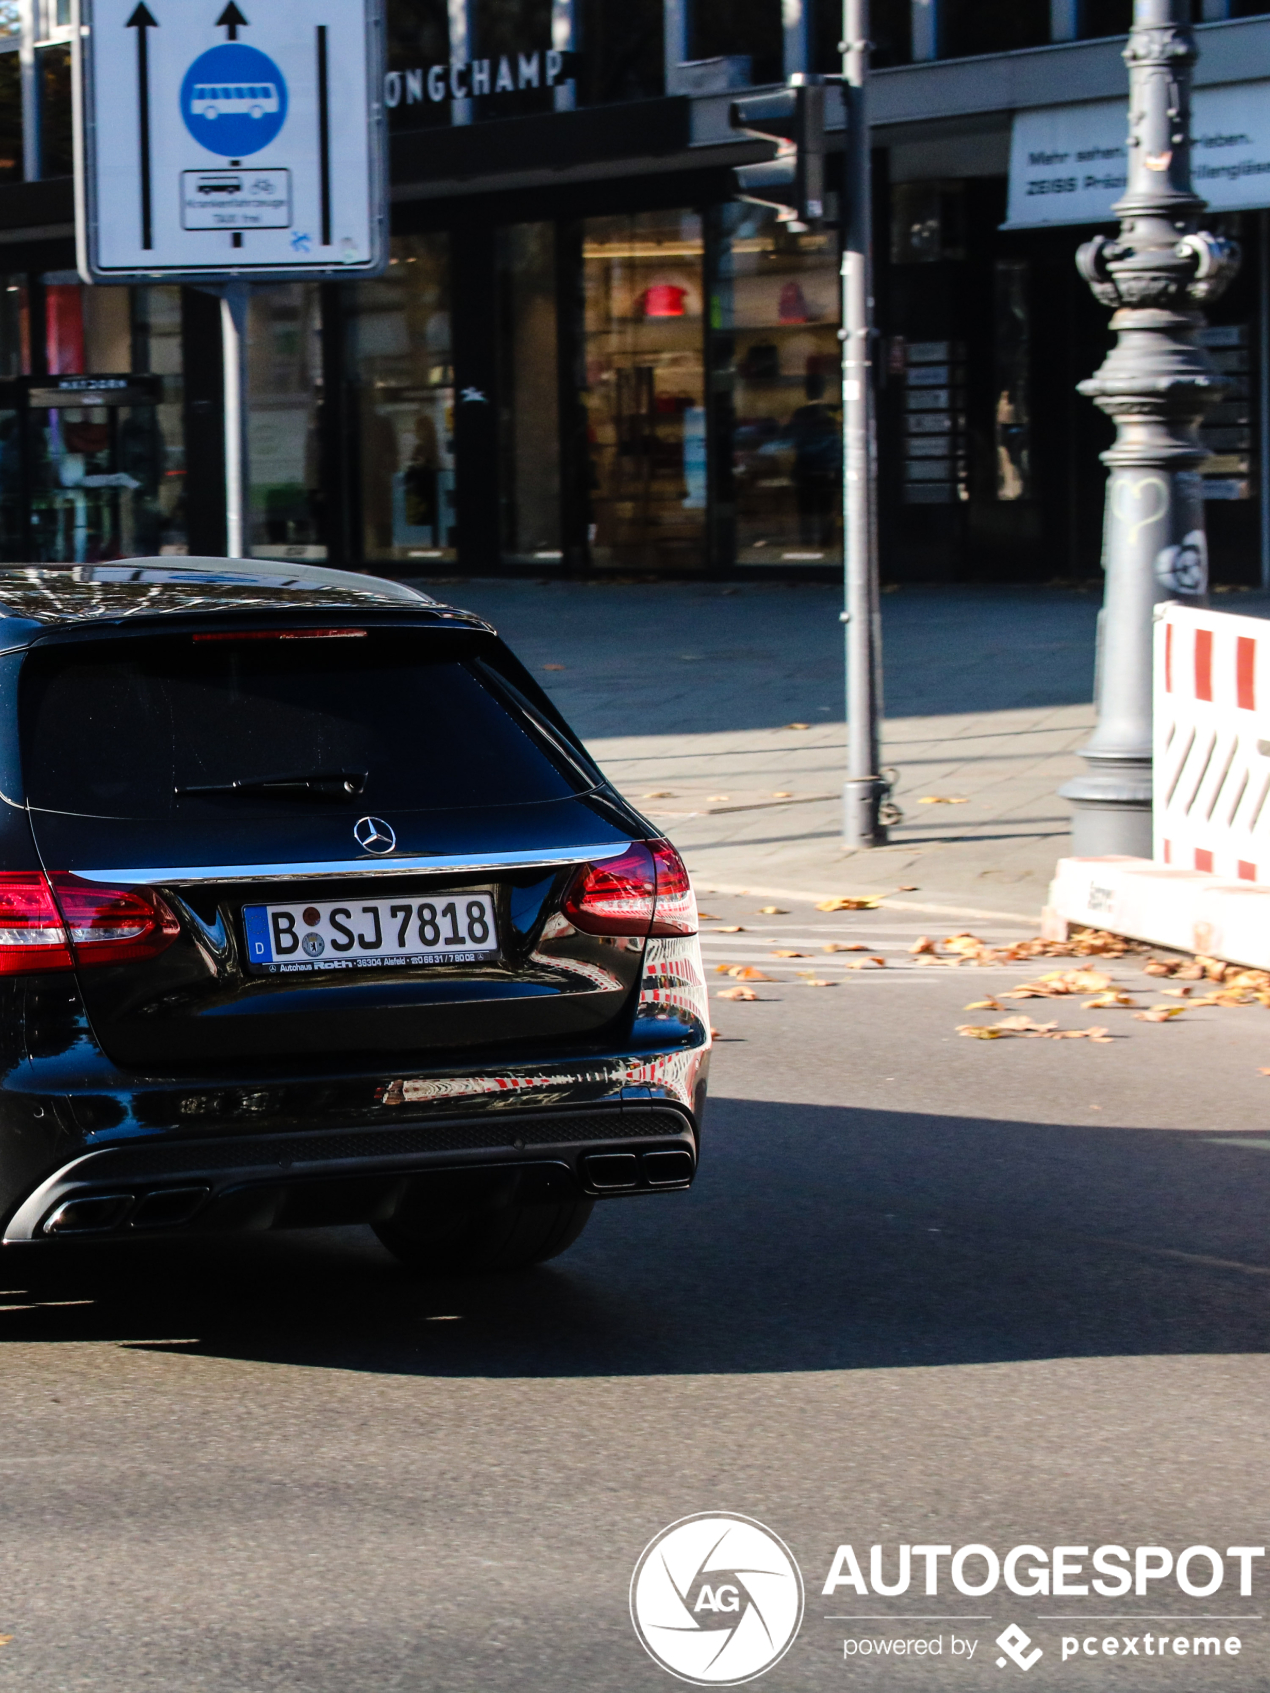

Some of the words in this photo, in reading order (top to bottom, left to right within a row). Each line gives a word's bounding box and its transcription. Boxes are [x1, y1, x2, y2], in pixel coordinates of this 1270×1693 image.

[383, 50, 564, 108] ONGCHAMP
[1026, 177, 1077, 197] ZEISS
[271, 911, 300, 956] B
[255, 942, 265, 955] D
[280, 963, 313, 973] Autohaus
[313, 960, 353, 971] Roth
[383, 957, 406, 967] Alsfeld
